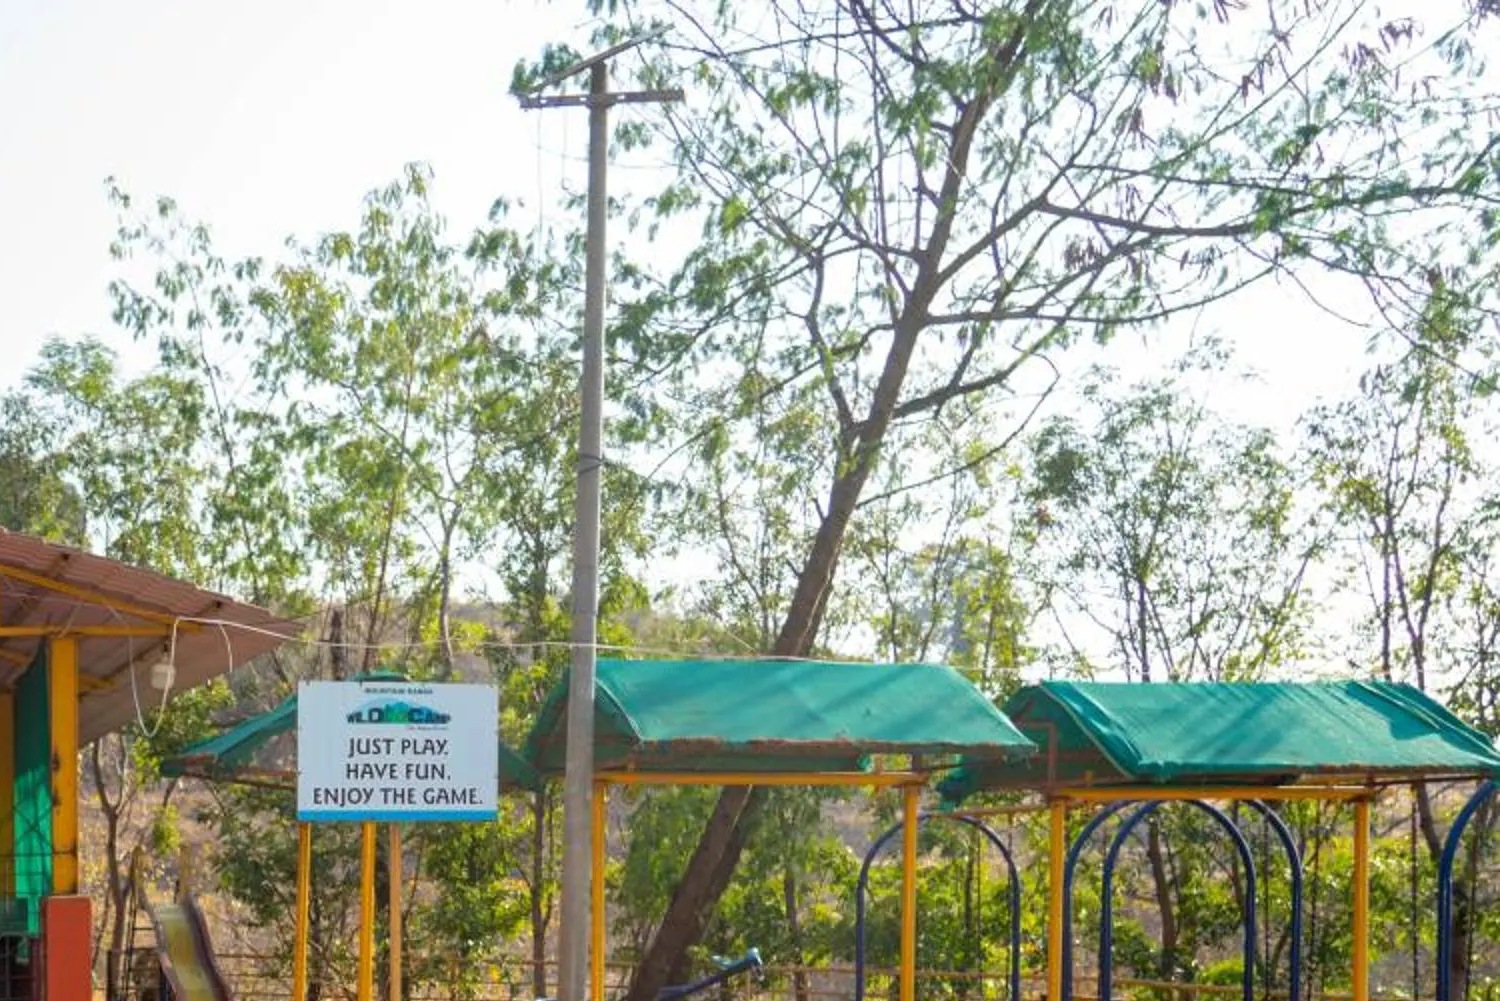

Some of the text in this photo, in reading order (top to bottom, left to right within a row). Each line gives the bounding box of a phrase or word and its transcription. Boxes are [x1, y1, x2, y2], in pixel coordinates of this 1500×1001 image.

[348, 737, 449, 758] JUST PLAY.
[345, 763, 451, 780] HAVE FUN.
[313, 787, 483, 807] ENJOY THE GAME.
